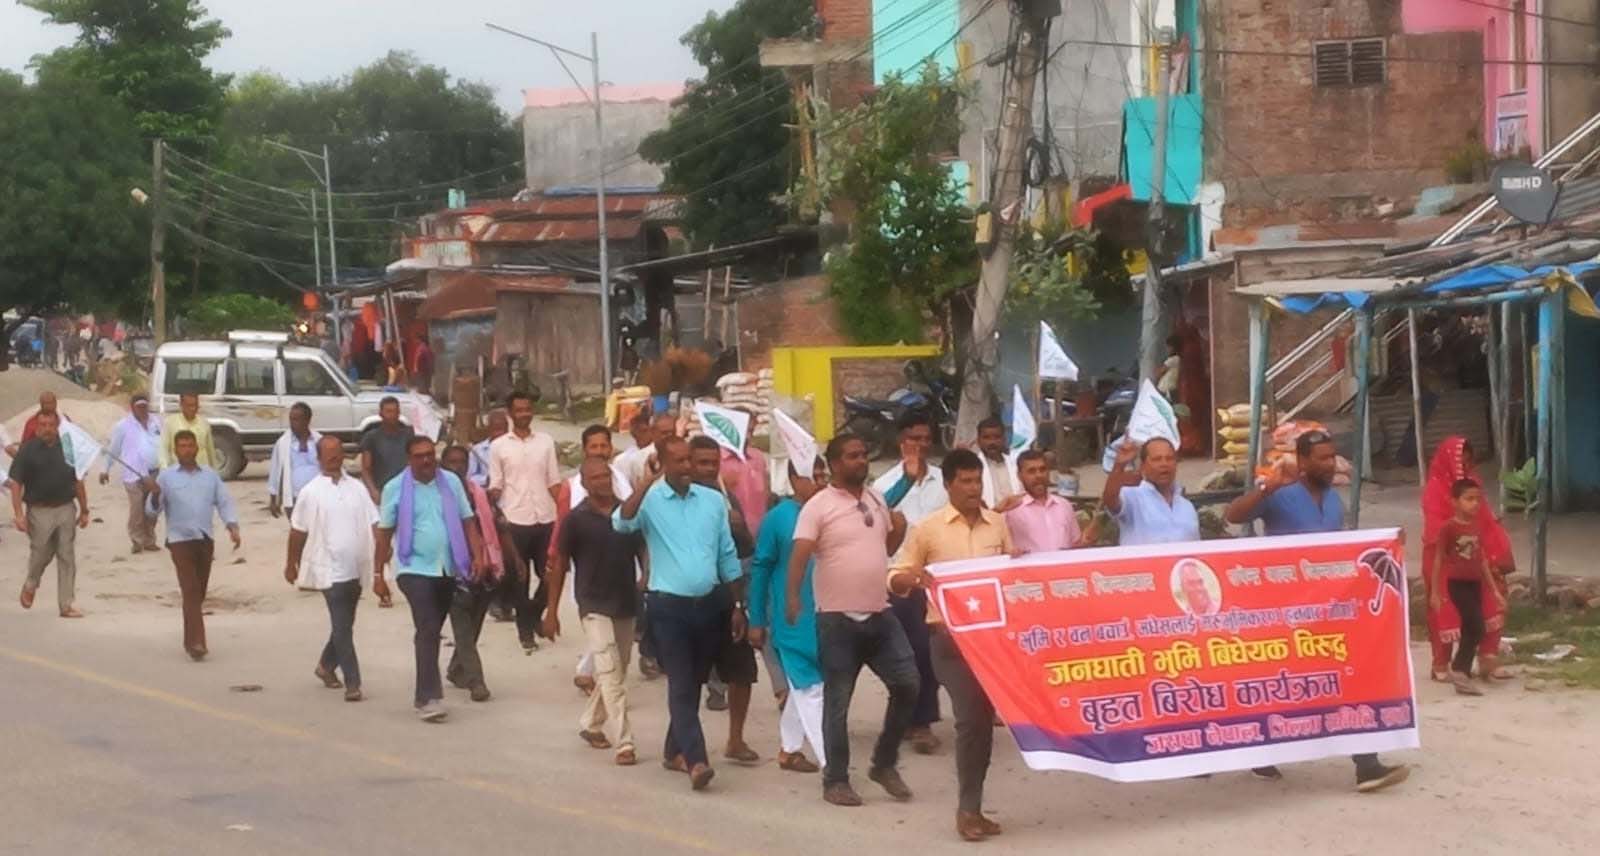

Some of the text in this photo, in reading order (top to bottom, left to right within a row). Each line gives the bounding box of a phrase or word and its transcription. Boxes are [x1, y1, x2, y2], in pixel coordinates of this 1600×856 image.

[1044, 646, 1146, 686] जनघाती
[1152, 640, 1203, 679] भुमि
[1079, 667, 1341, 734] बृहत बिरोध कार्यक्रम
